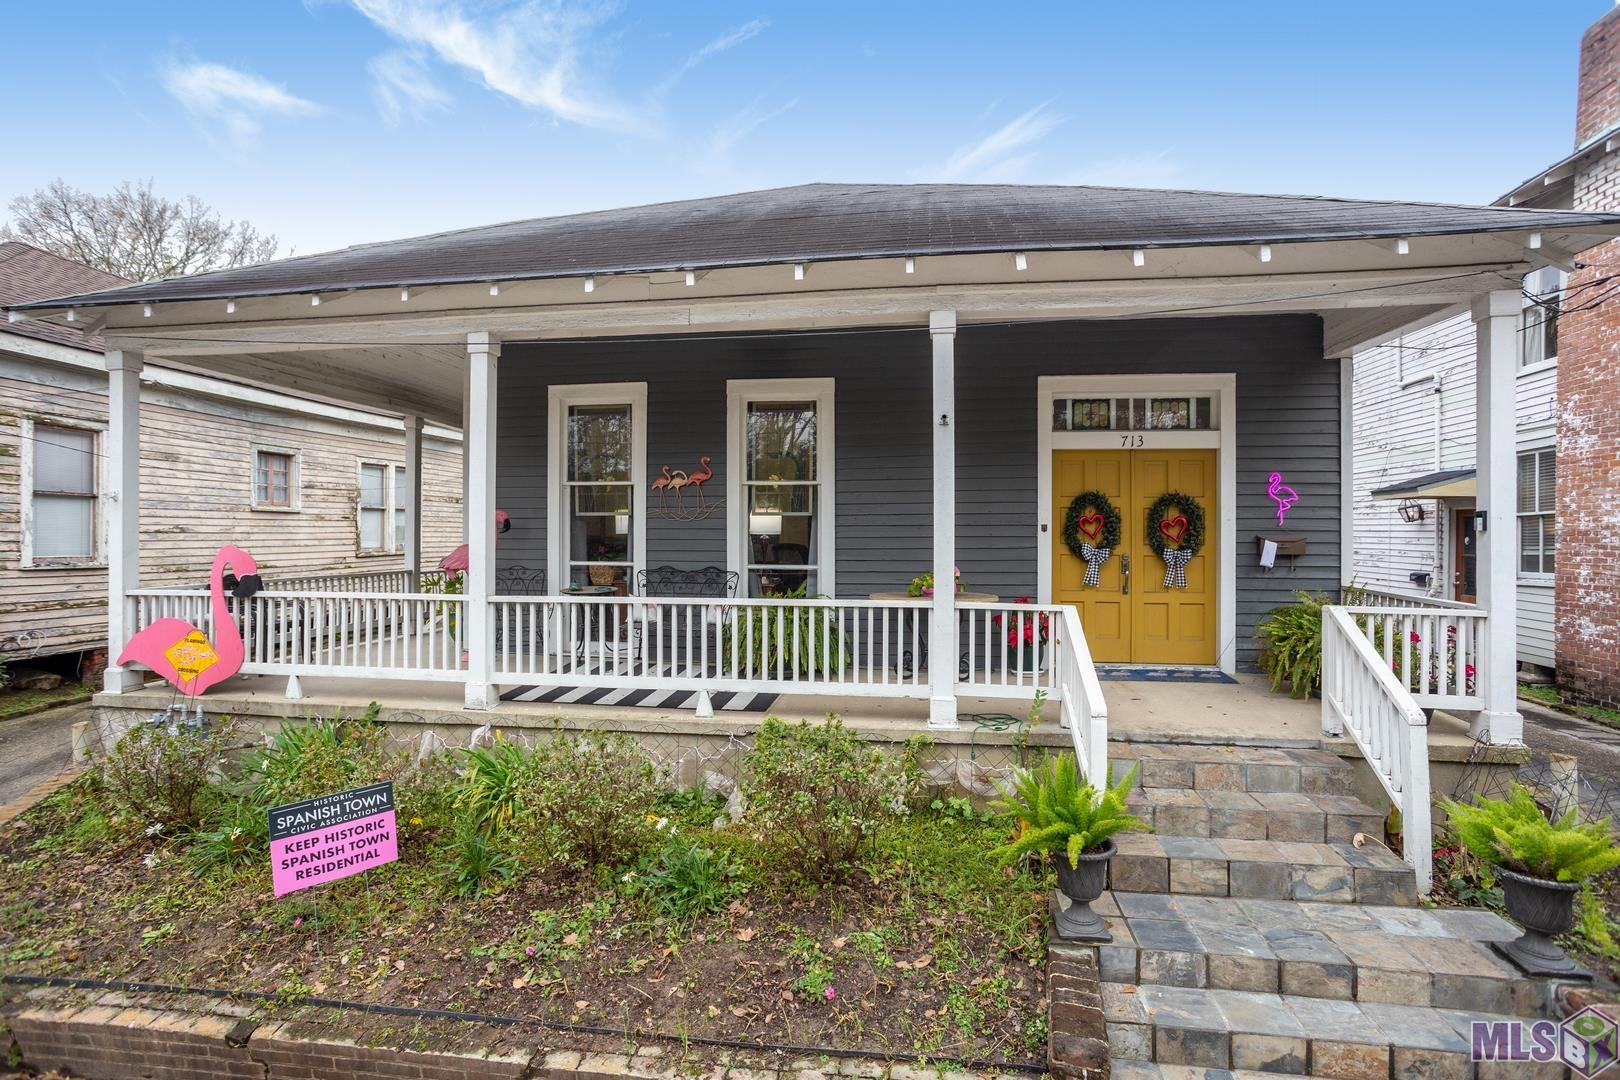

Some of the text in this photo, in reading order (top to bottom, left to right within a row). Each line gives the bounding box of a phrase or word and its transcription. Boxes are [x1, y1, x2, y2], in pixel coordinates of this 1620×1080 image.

[1120, 435, 1144, 447] 713
[277, 792, 387, 829] SPANISH TOWN
[313, 792, 354, 807] HISTORIC
[285, 819, 385, 854] KEEP HISTORIC
[290, 807, 378, 834] CIVIC ASSOCIATION
[281, 832, 390, 870] SPANISH TOWN
[296, 848, 380, 880] RESIDENTIAL
